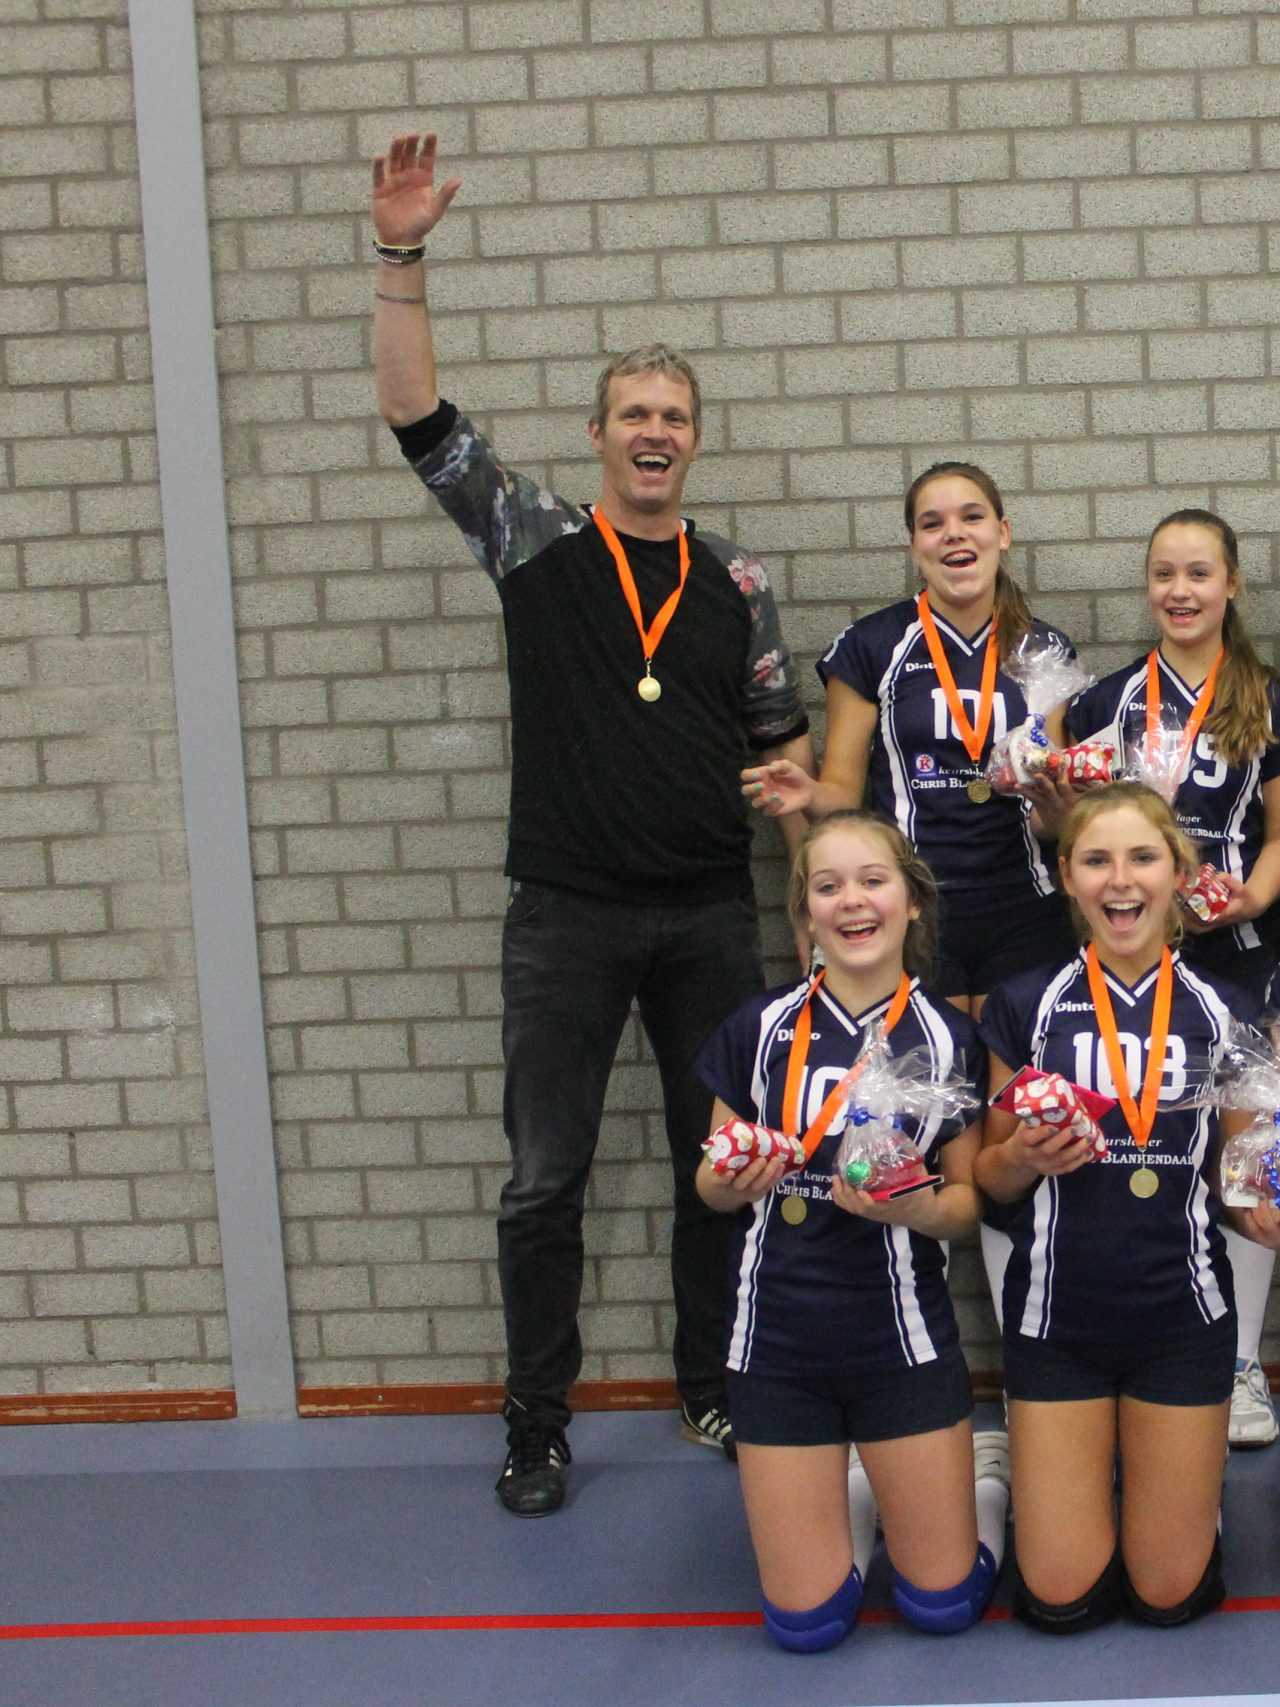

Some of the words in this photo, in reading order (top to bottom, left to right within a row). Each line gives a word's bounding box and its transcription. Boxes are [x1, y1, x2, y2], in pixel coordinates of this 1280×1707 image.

[905, 662, 936, 673] Dint
[1129, 702, 1164, 712] Dio
[777, 1028, 822, 1042] Dio
[1105, 1135, 1163, 1147] ursler
[803, 1170, 832, 1183] keurs
